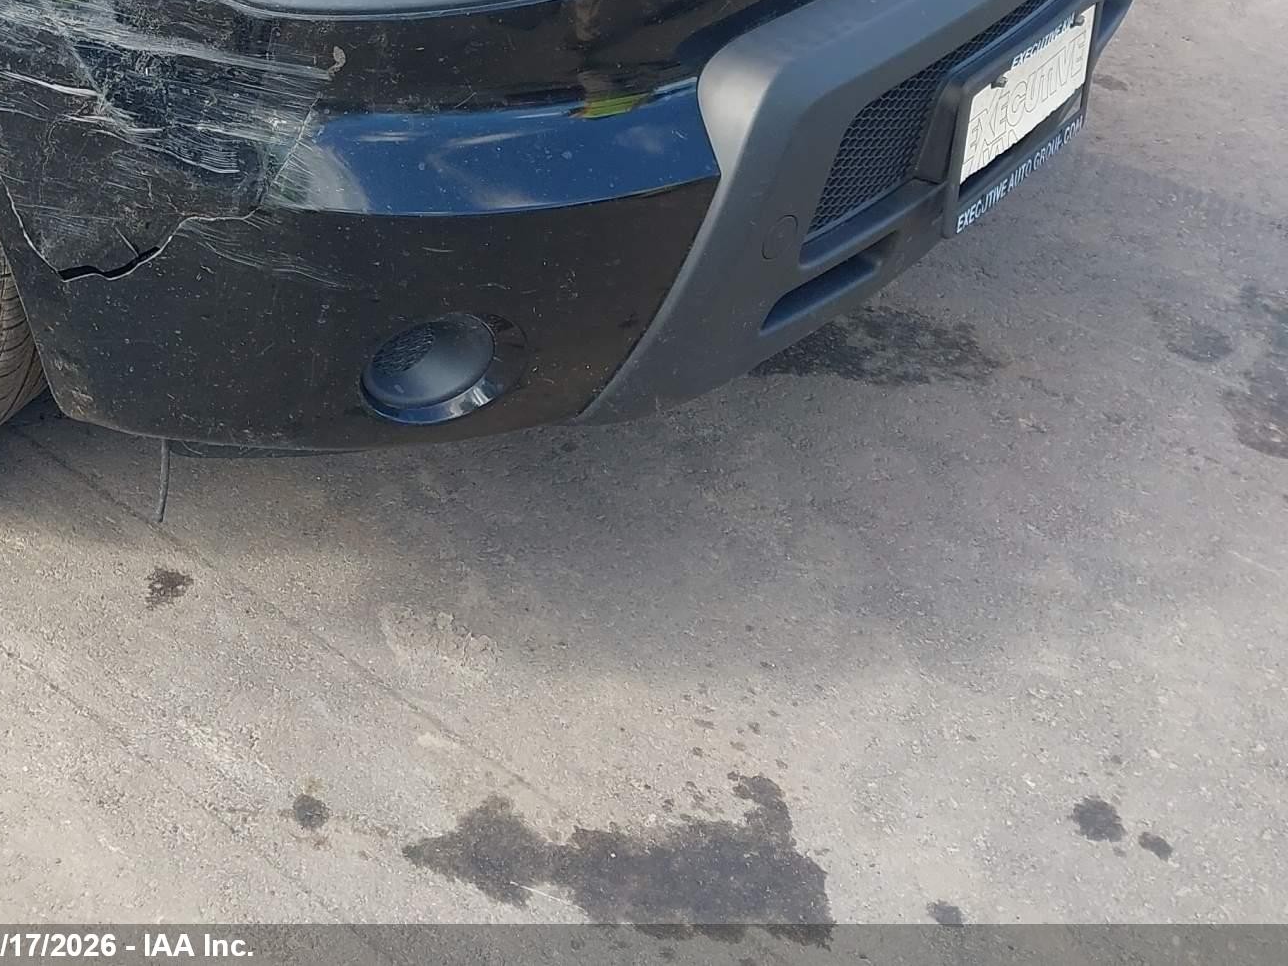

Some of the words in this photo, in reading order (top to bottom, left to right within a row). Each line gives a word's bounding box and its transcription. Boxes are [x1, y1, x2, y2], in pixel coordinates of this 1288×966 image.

[962, 29, 1087, 164] EXECUTIVE
[956, 178, 1008, 235] EXECUTIVE
[1007, 159, 1032, 193] AUTO
